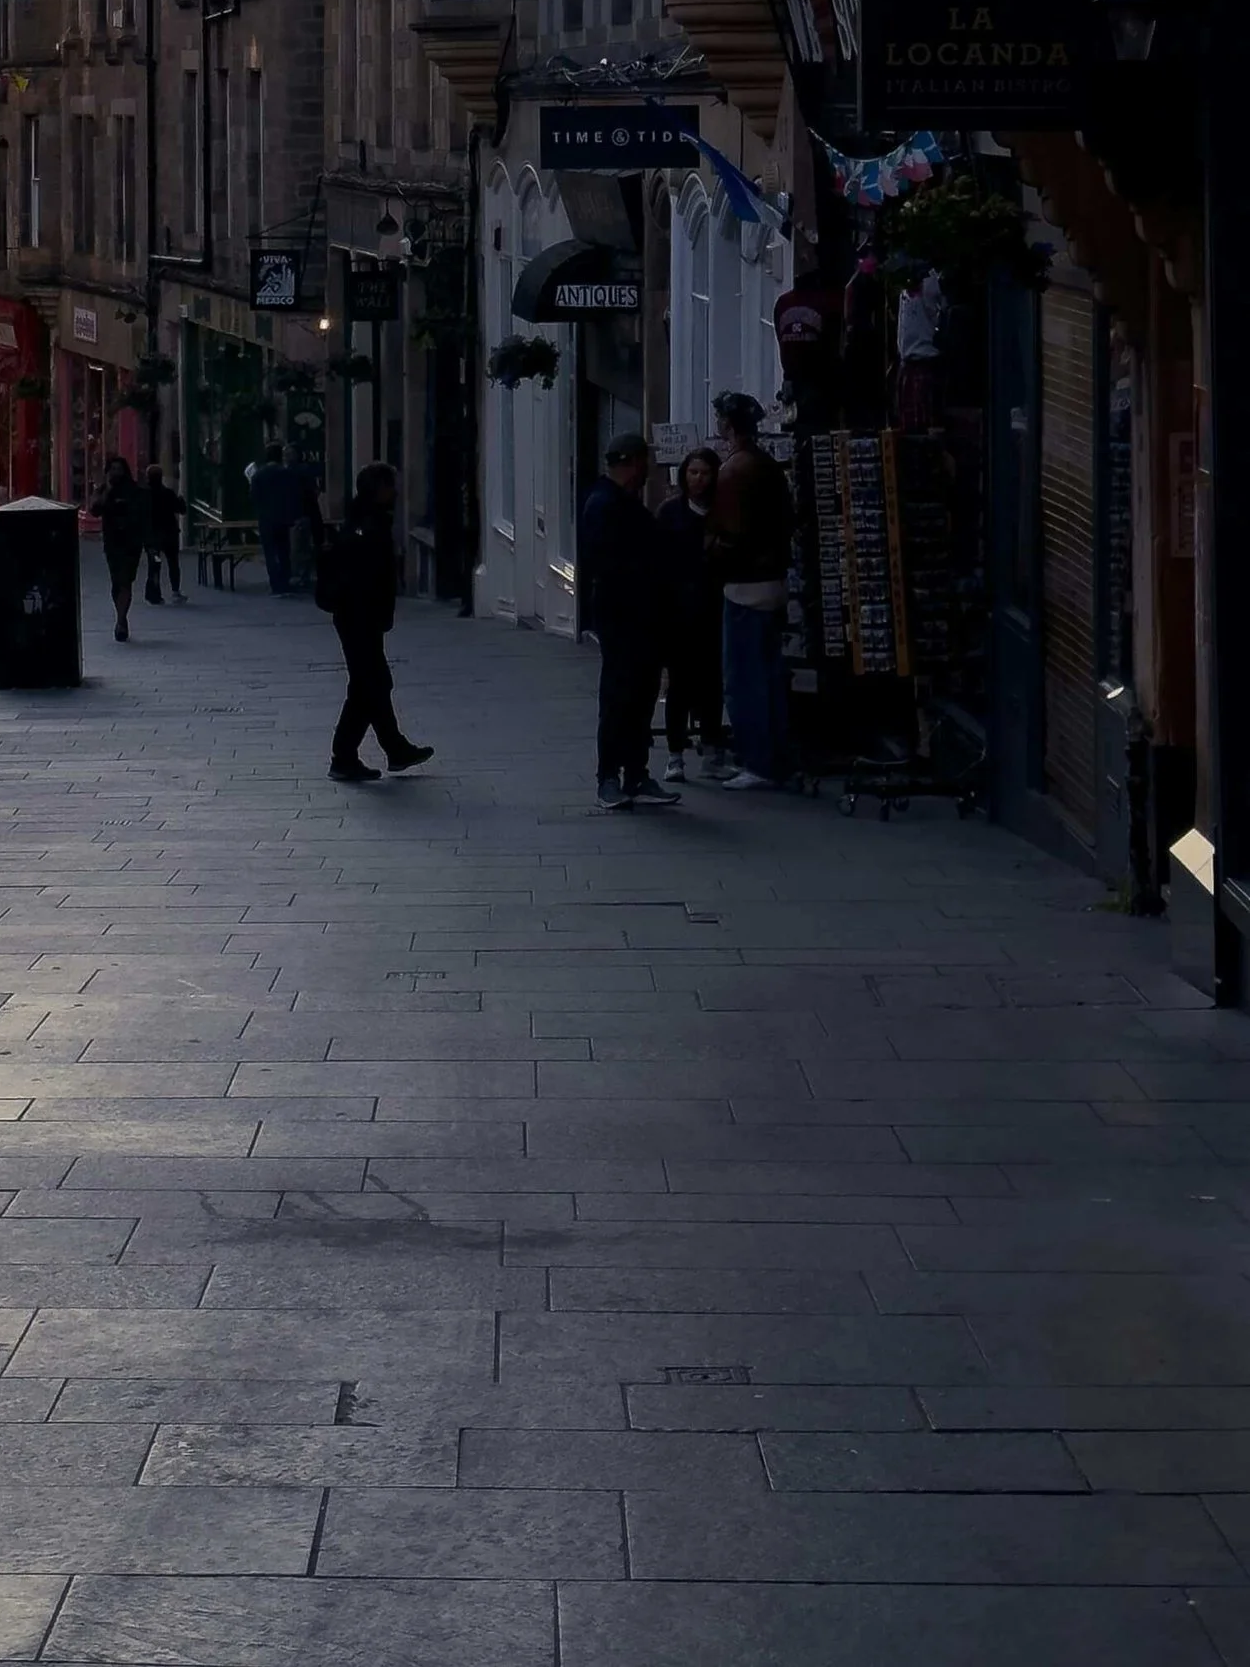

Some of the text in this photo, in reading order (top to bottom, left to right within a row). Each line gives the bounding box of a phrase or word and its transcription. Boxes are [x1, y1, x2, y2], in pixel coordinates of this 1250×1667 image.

[947, 5, 994, 31] LA
[885, 41, 1071, 67] LOCANDA
[886, 78, 986, 94] ITALIAN
[552, 130, 603, 144] TIME
[636, 130, 688, 144] TIDE
[262, 255, 288, 264] VIVA
[357, 280, 388, 293] THE
[256, 295, 295, 306] MEXICO
[355, 294, 391, 308] WALL
[557, 285, 637, 307] ANTIQUES
